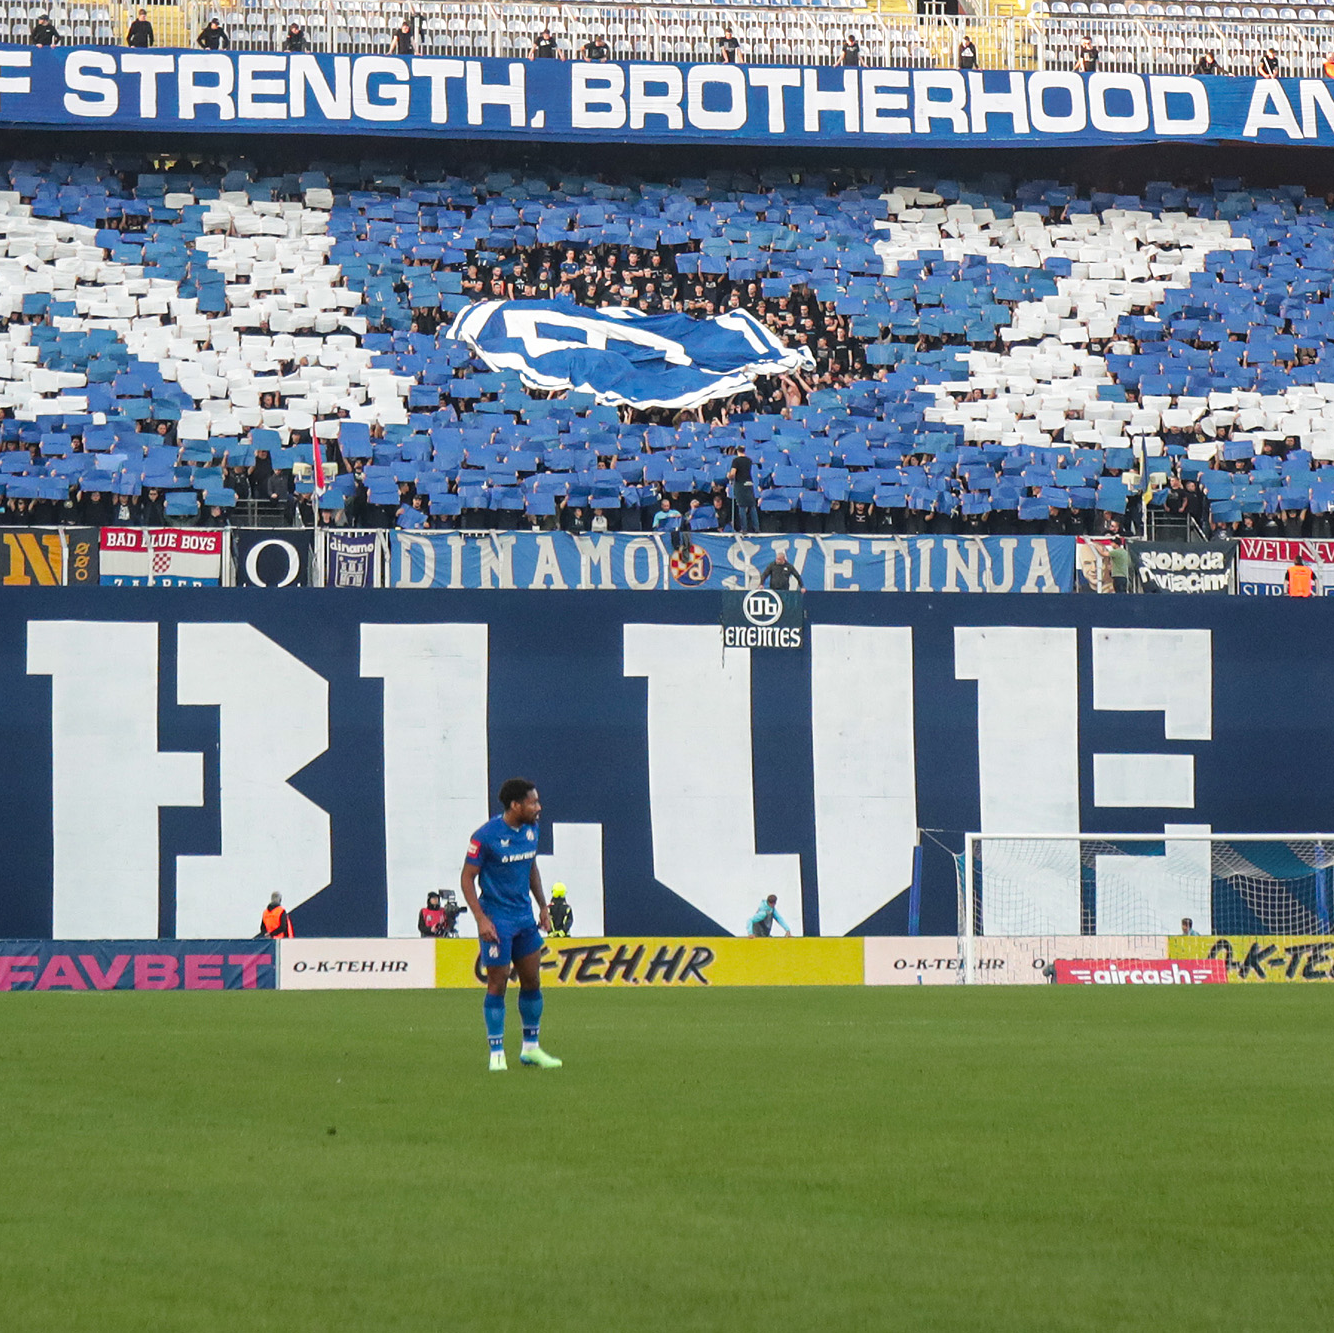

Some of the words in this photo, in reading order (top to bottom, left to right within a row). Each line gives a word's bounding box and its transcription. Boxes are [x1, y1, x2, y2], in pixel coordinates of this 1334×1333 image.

[64, 50, 545, 128] STRENGTH,
[571, 62, 1211, 136] BROTHERHOOD
[106, 532, 136, 547] BAD
[141, 533, 177, 549] BLUE
[181, 535, 216, 551] BOYS
[330, 537, 374, 553] dinamo
[397, 534, 661, 589] DINAMO
[721, 537, 1060, 593] SVETINJA
[26, 620, 1213, 938] BLUE
[293, 960, 409, 973] O-K-TEH.HR
[474, 943, 711, 986] -TEH.HR
[1093, 963, 1193, 985] aircash
